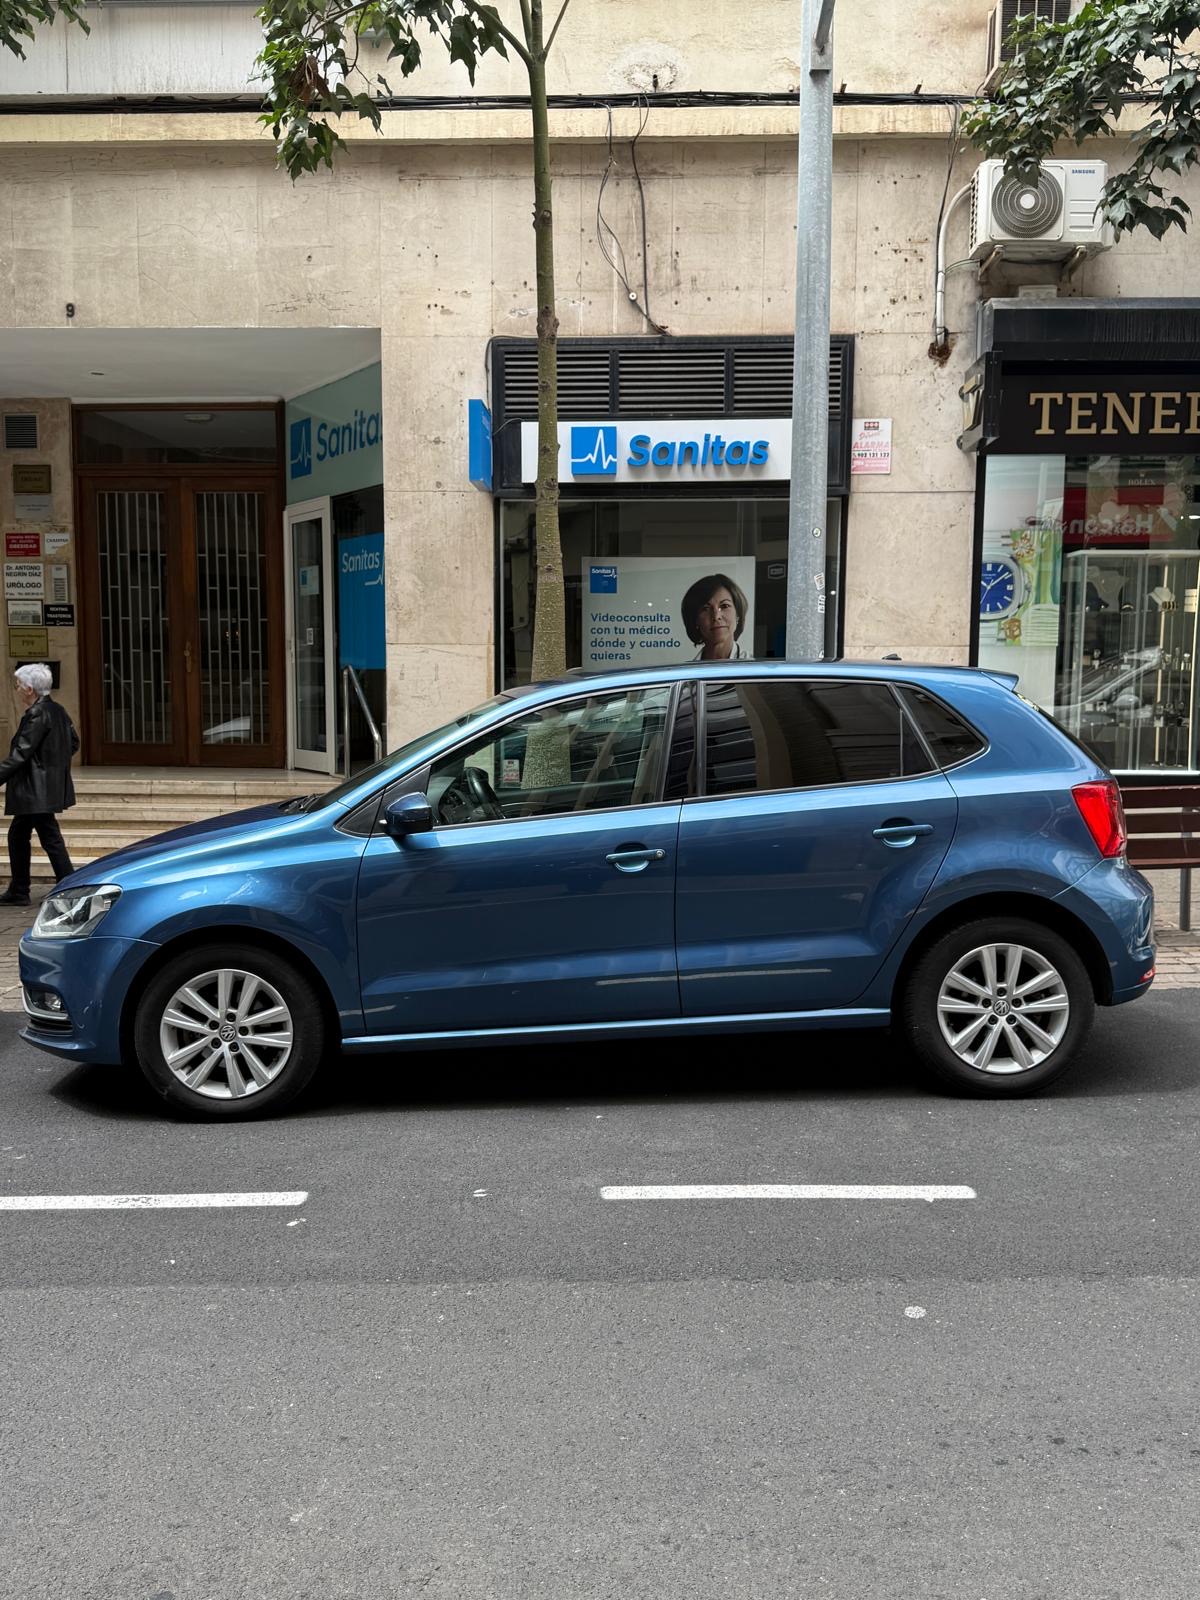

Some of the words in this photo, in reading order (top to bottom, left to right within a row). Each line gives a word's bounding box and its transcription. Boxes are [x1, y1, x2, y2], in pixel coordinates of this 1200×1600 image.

[66, 302, 75, 318] 9
[316, 409, 383, 462] Sanita
[627, 433, 770, 467] Sanitas
[342, 548, 380, 573] Sanitas
[590, 612, 671, 623] Videoconsulta
[590, 626, 611, 635] con
[614, 625, 625, 635] tu
[628, 625, 671, 635] médico
[590, 638, 626, 648] dónde
[629, 640, 636, 649] y
[639, 638, 681, 648] cuando
[590, 651, 632, 660] quieras
